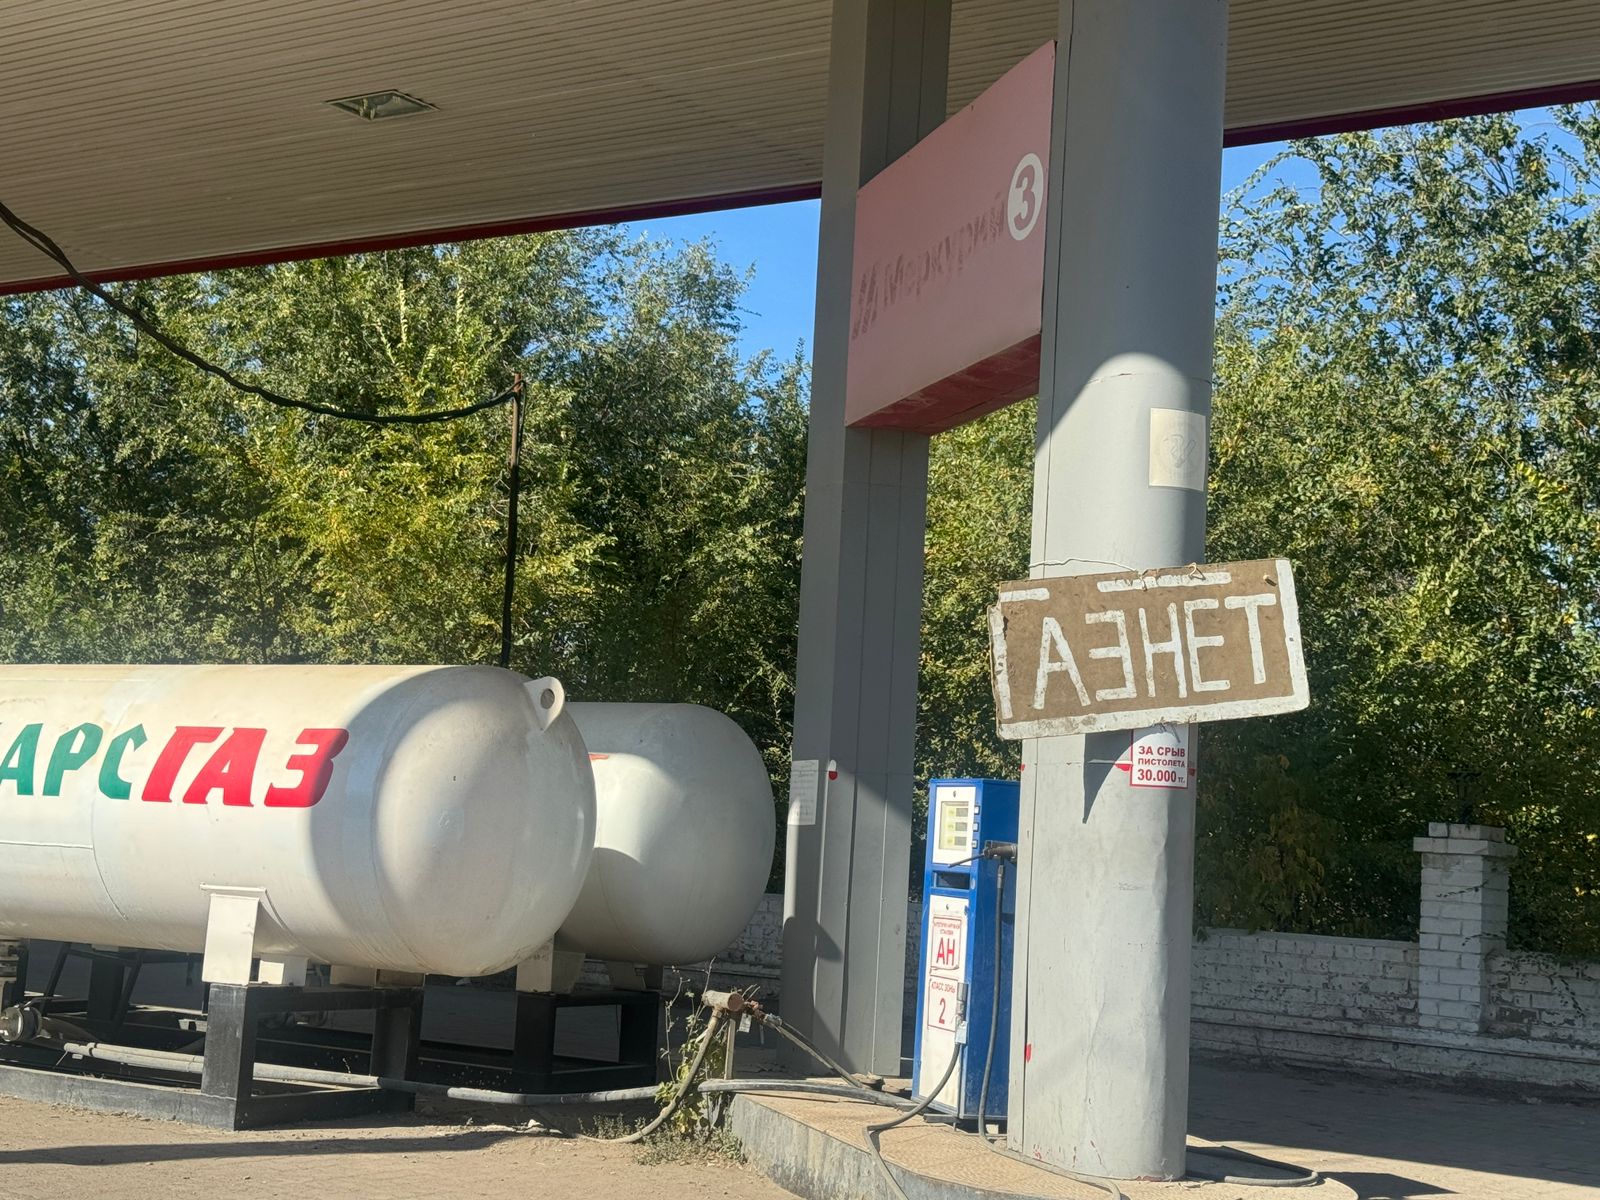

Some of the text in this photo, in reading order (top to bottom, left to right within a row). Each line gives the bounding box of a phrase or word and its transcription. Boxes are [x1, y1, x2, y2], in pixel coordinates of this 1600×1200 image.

[1014, 164, 1036, 231] 3
[0, 722, 349, 808] АРСГАЗ
[1138, 746, 1186, 757] ЗА СРЫВ
[1137, 769, 1177, 782] 30.000
[936, 937, 955, 966] АН
[938, 998, 946, 1024] 2
